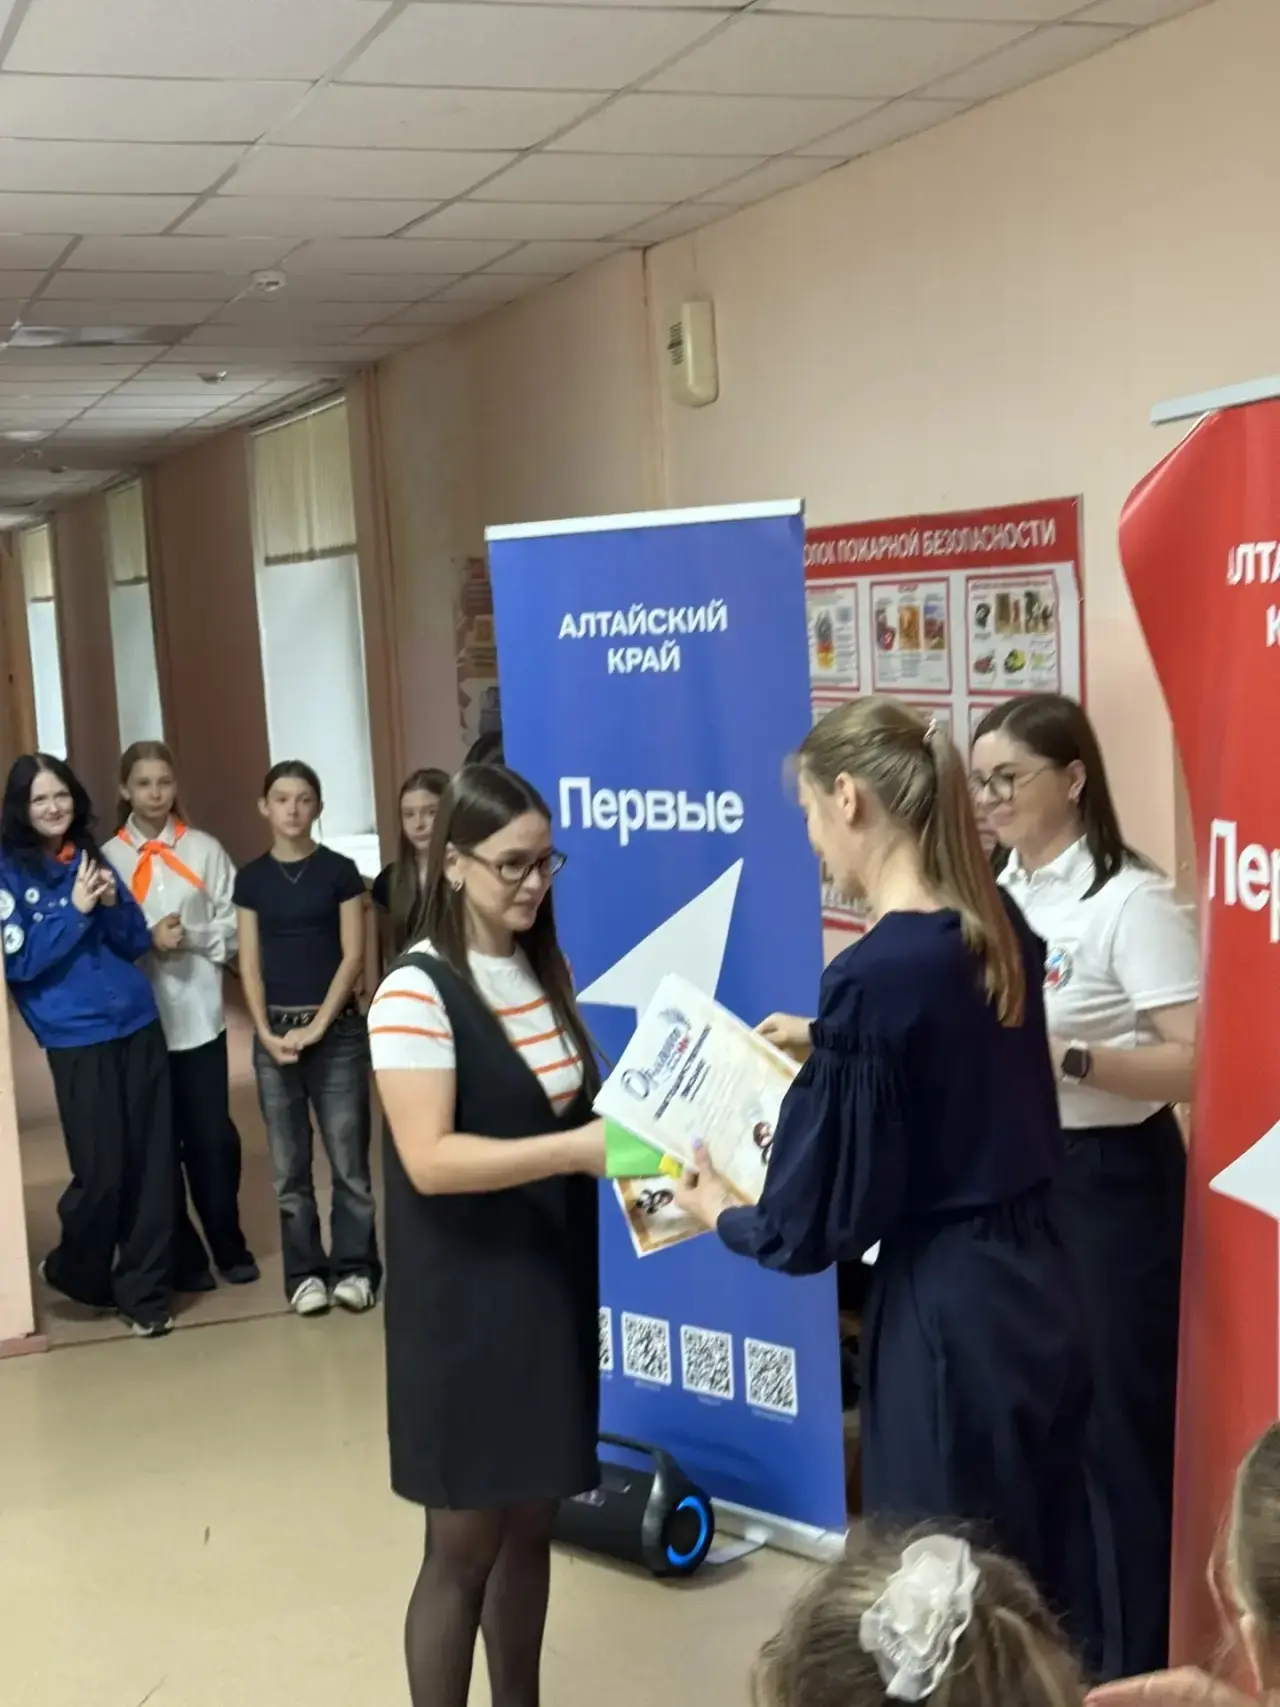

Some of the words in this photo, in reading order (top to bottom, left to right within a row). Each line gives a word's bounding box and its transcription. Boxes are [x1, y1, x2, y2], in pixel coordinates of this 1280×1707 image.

[837, 527, 920, 563] ПОЖАРНОЙ
[922, 517, 1057, 557] БЕЗОПАСНОСТИ
[558, 598, 728, 639] АЛТАЙСКИЙ
[607, 640, 681, 674] КРАЙ
[558, 776, 744, 847] Первые
